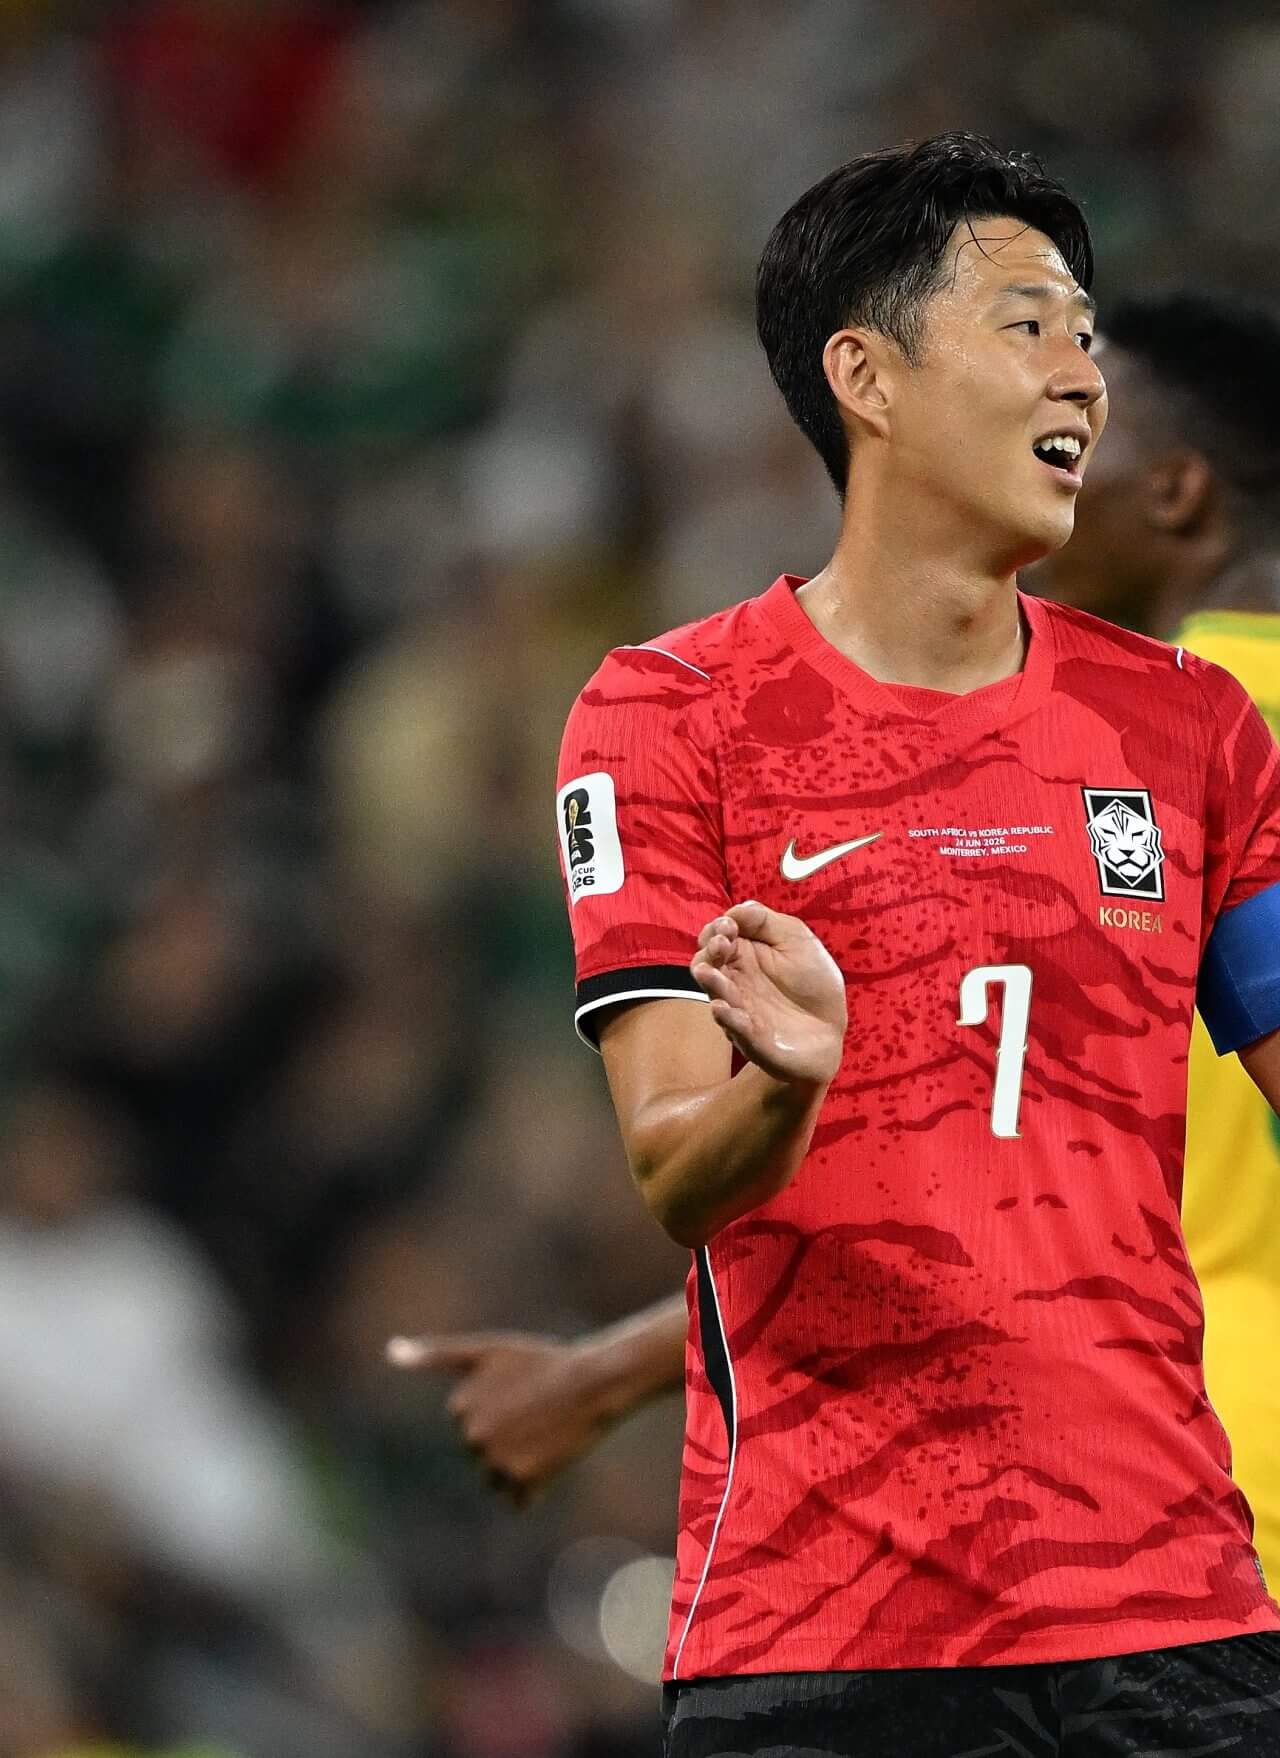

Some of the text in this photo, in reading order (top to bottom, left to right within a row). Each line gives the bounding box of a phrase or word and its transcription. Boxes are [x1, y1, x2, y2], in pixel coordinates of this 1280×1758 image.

[908, 828, 939, 838] SOUTH
[941, 828, 967, 837] AFRICA
[979, 827, 1008, 837] KOREA
[1011, 826, 1054, 835] REPUBLIC
[966, 839, 981, 847] JUN
[984, 837, 1005, 846] 2026
[991, 845, 1027, 855] MEXICO
[1100, 906, 1162, 934] KOREA
[956, 964, 1033, 1138] 7
